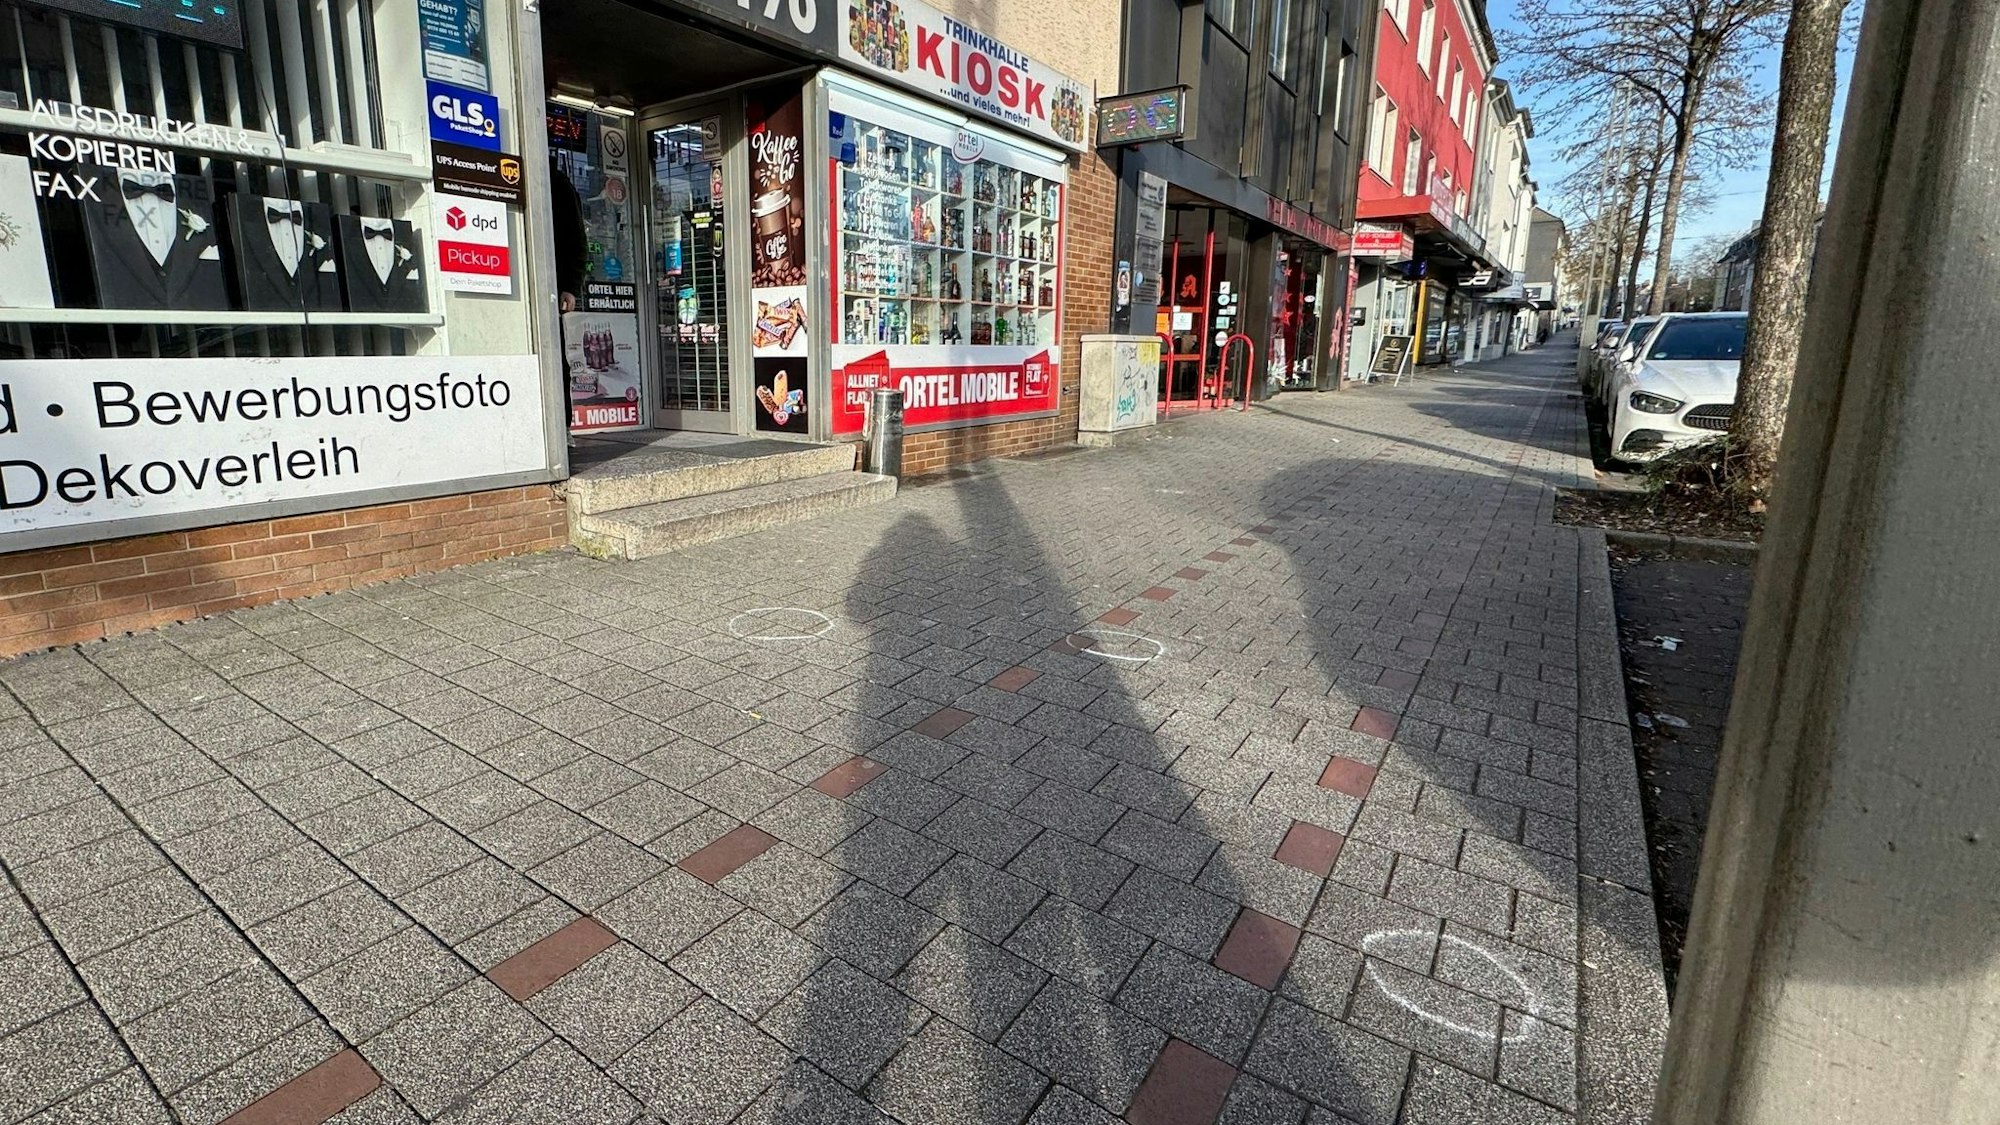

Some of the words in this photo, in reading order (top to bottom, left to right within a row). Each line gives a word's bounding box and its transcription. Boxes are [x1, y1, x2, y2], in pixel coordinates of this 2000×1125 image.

[420, 0, 458, 16] GEHABT?
[943, 16, 1029, 73] TRINKHALLE
[917, 25, 1045, 120] KIOSK
[432, 95, 484, 126] GLS
[973, 96, 1001, 116] vieles
[30, 99, 231, 150] AUSDRUCKEN
[238, 130, 255, 154] &
[450, 122, 484, 137] PaketShop
[752, 130, 798, 165] Kaffee
[958, 132, 979, 146] ortel
[958, 143, 978, 153] MOBILE
[28, 131, 176, 175] KOPIEREN
[868, 152, 896, 170] Zeung
[436, 155, 452, 165] UPS
[453, 158, 476, 171] Access
[779, 152, 796, 184] Go
[502, 166, 518, 181] ups
[862, 166, 900, 181] Spirosen
[32, 170, 101, 202] FAX
[884, 206, 893, 218] To
[472, 214, 497, 231] dpd
[448, 248, 500, 270] Pickup
[588, 284, 614, 295] ORTEL
[615, 285, 633, 296] HIER
[589, 297, 635, 309] ERHÄLTLICH
[847, 374, 879, 389] ALLNET
[1026, 370, 1041, 383] FLAT
[900, 374, 958, 410] ORTEL
[961, 371, 1019, 405] MOBILE
[93, 373, 511, 428] Bewerbungsfoto
[587, 406, 637, 425] MOBILE
[0, 436, 360, 511] Dekoverleih
